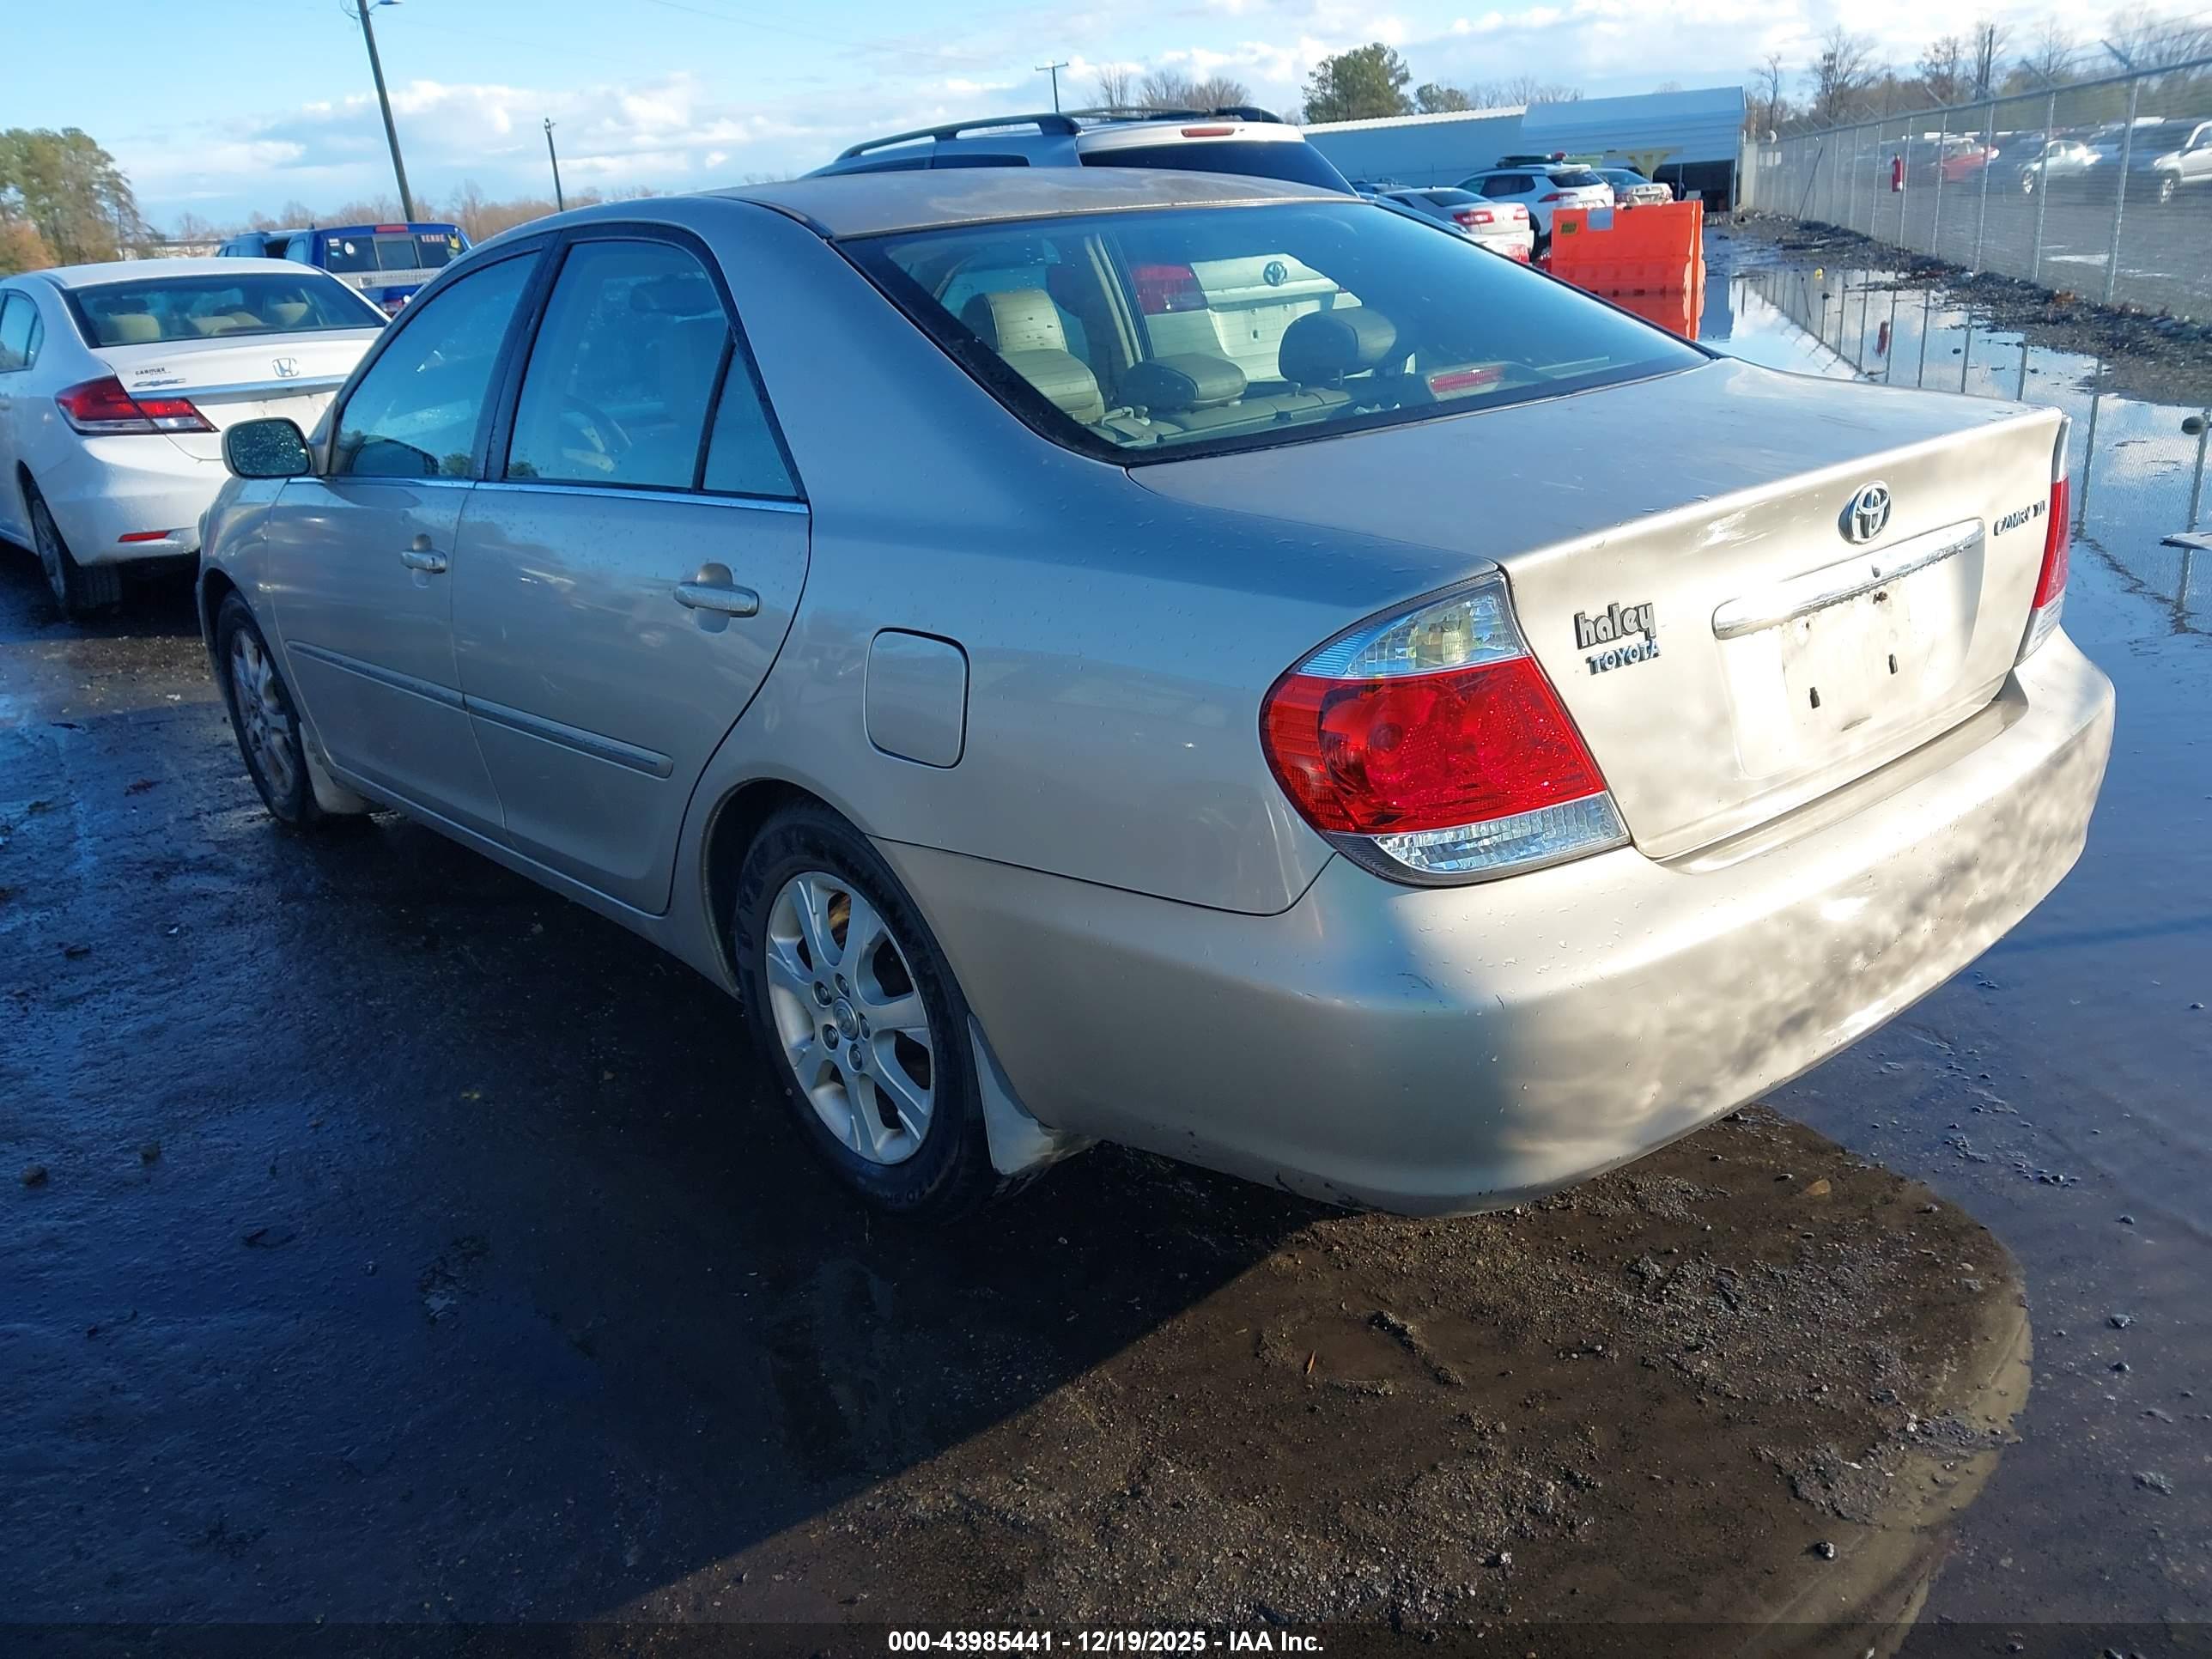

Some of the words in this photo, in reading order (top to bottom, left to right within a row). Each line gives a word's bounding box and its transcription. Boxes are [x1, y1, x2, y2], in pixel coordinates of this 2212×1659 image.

[1993, 505, 2031, 537] CAMRY
[1574, 602, 1657, 650] haley
[1585, 639, 1662, 676] TOYOTA
